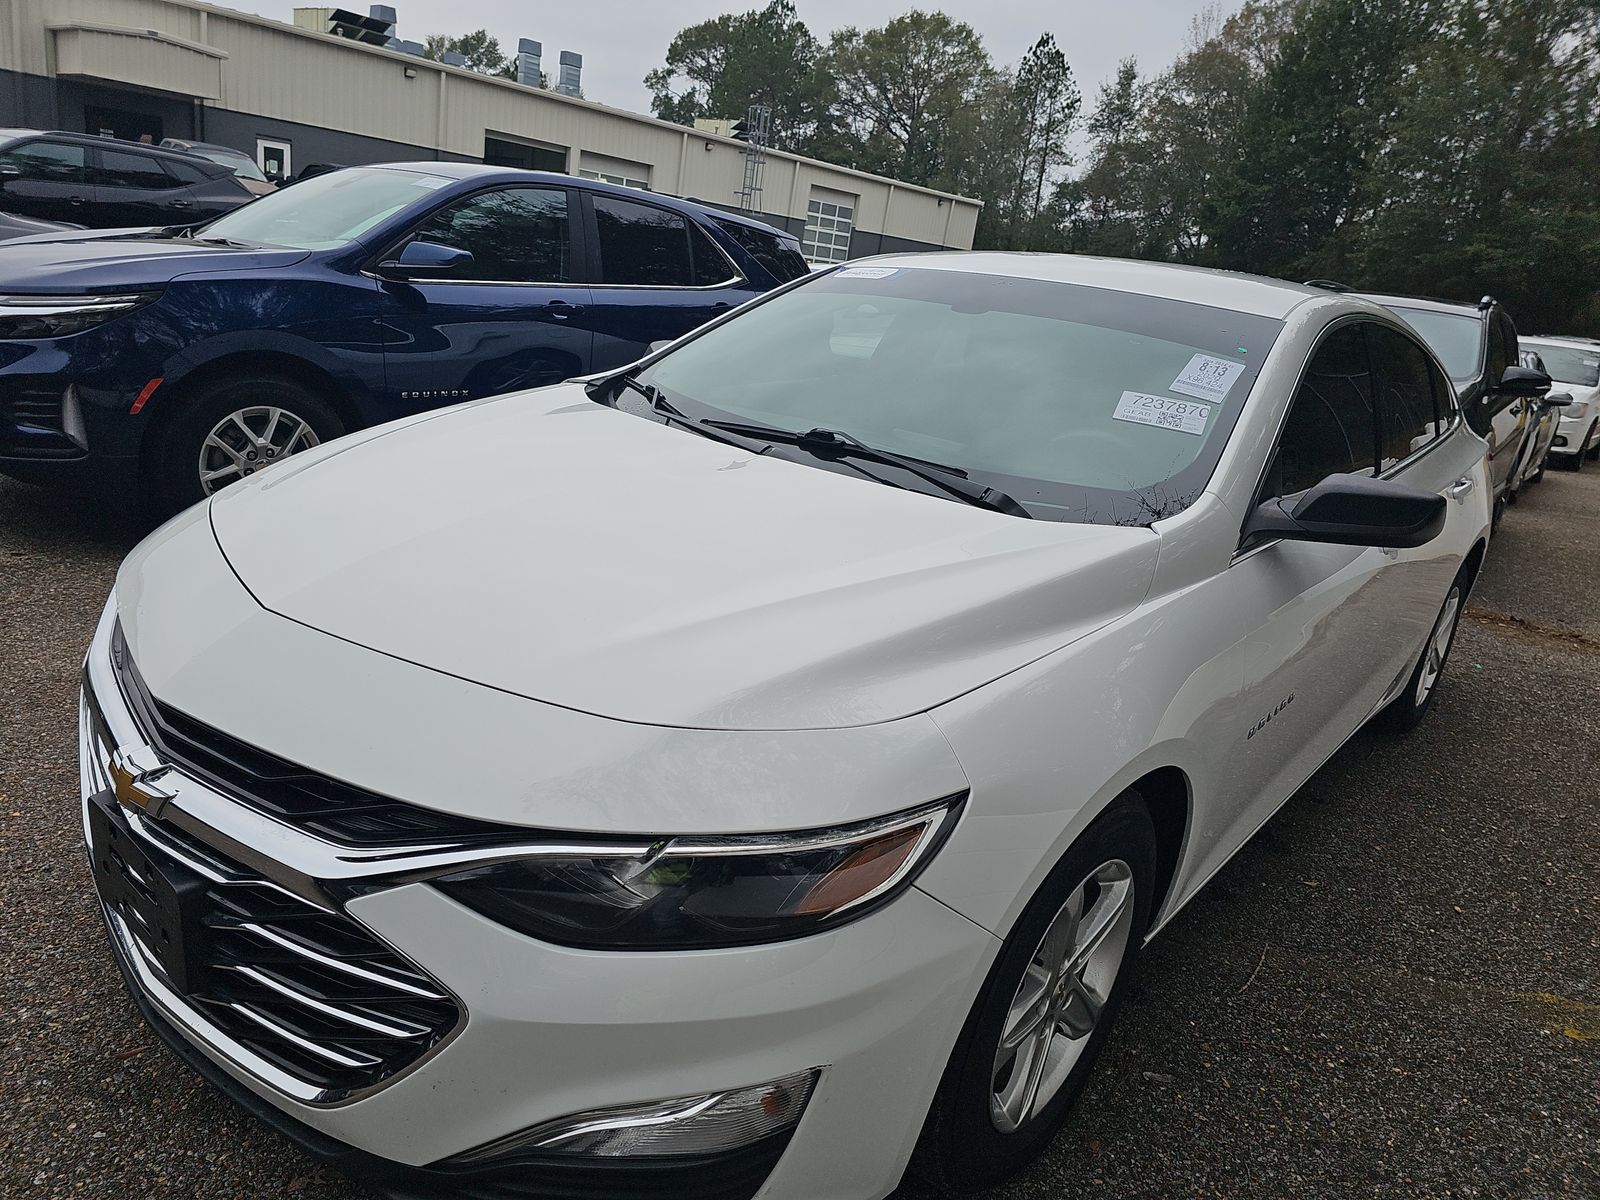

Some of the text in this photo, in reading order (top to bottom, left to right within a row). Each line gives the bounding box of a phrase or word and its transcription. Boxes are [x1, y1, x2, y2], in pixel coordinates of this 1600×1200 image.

[1199, 362, 1228, 377] 8:13
[401, 390, 469, 399] EQUINOX
[1132, 395, 1210, 418] 7237870
